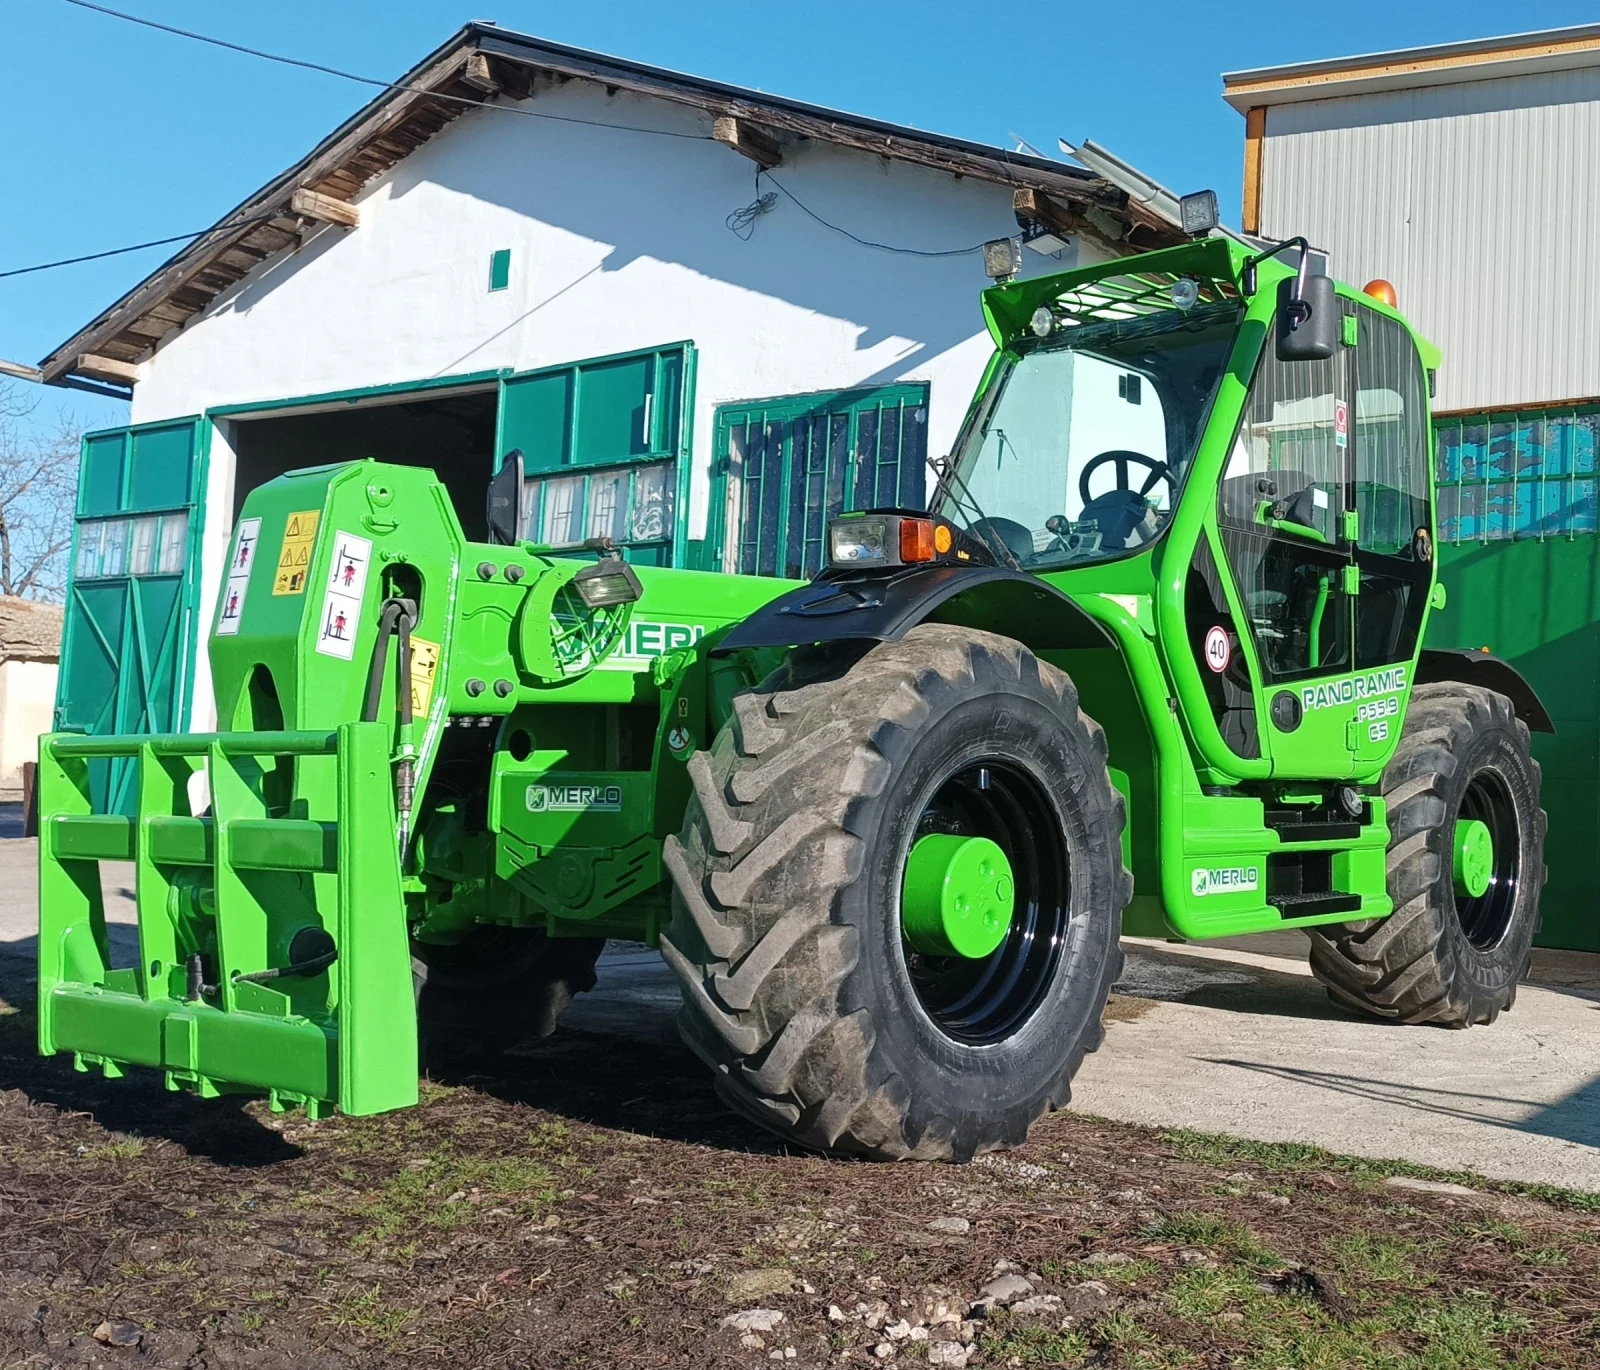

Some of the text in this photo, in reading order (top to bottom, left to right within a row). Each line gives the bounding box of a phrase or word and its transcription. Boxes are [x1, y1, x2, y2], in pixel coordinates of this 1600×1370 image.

[1210, 639, 1225, 659] 40
[1303, 669, 1405, 711] PANORAMIC
[1358, 698, 1398, 721] P55.9
[1369, 723, 1388, 742] CS
[549, 787, 621, 805] MERLO
[1209, 868, 1257, 886] MERLO
